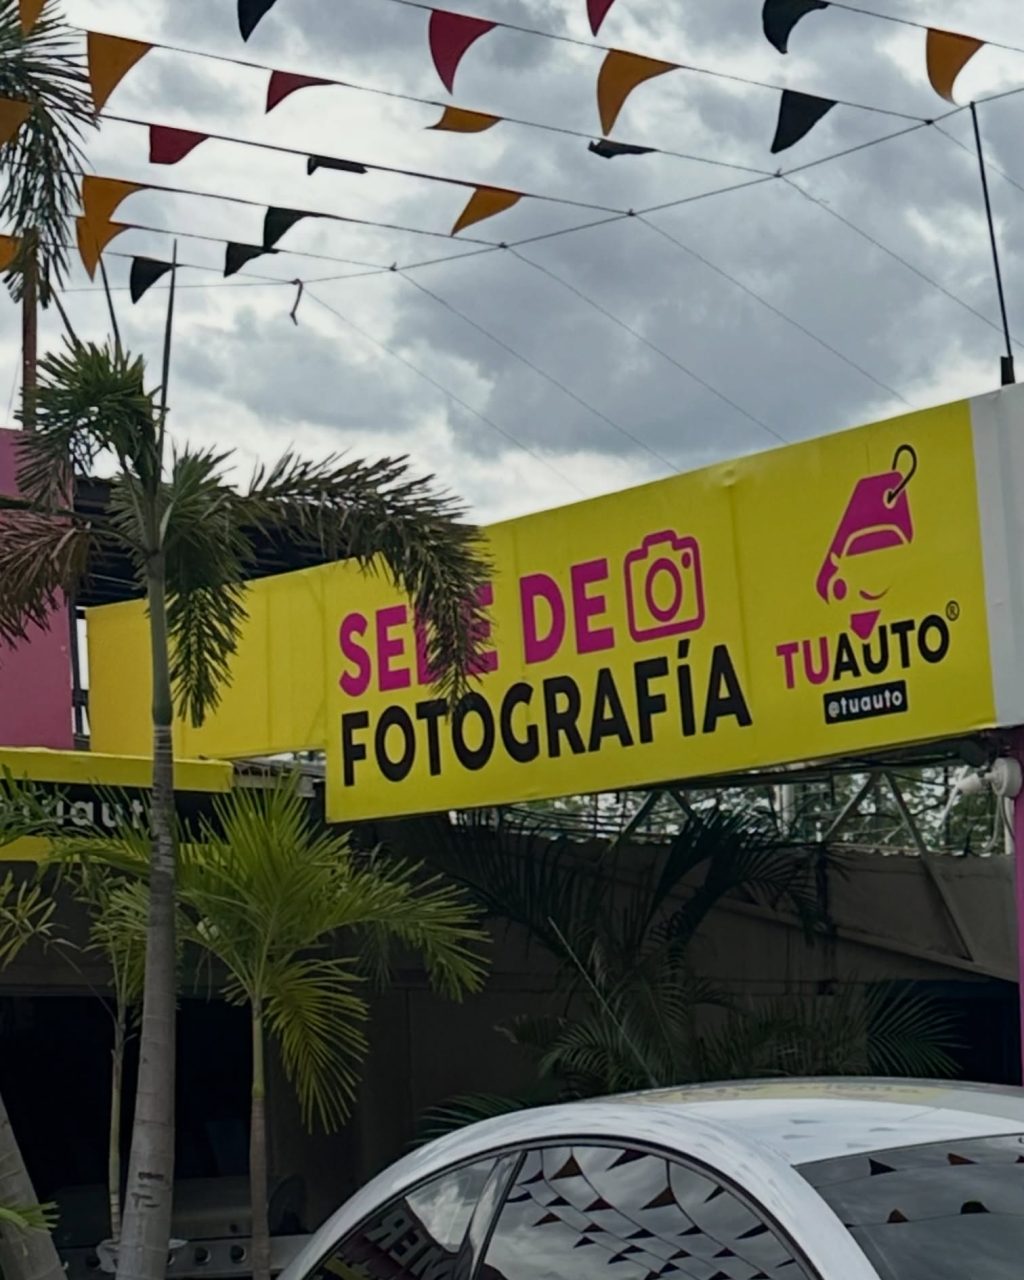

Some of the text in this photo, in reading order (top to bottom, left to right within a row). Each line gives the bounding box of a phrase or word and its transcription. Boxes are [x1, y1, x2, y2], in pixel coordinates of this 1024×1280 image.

[519, 558, 615, 665] DE
[341, 638, 753, 788] FOTOGRAFÍA
[828, 690, 903, 719] @tuauto
